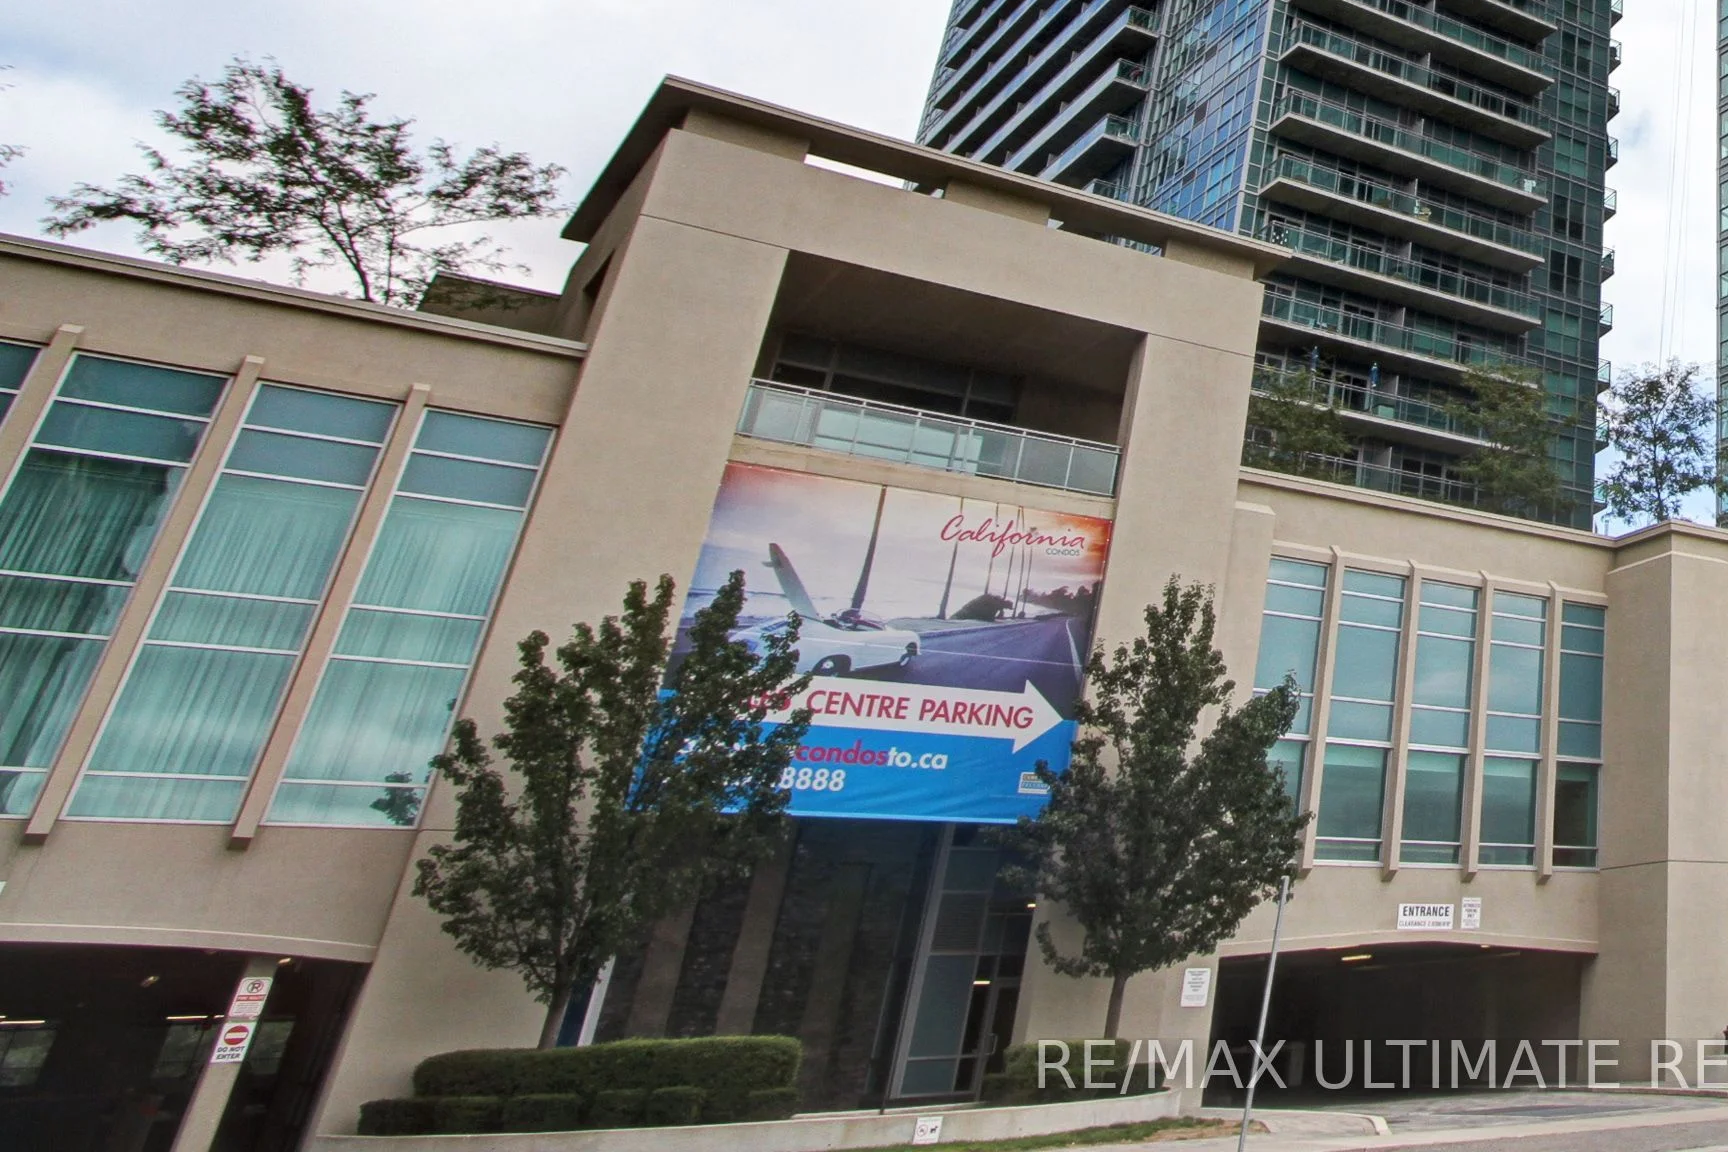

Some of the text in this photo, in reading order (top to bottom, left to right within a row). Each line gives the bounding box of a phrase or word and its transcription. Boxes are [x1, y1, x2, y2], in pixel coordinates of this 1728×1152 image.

[940, 514, 1084, 558] California
[1045, 548, 1081, 557] CONDOS
[807, 690, 910, 719] CENTRE
[919, 699, 1034, 729] PARKING
[1402, 905, 1450, 917] ENTRANCE
